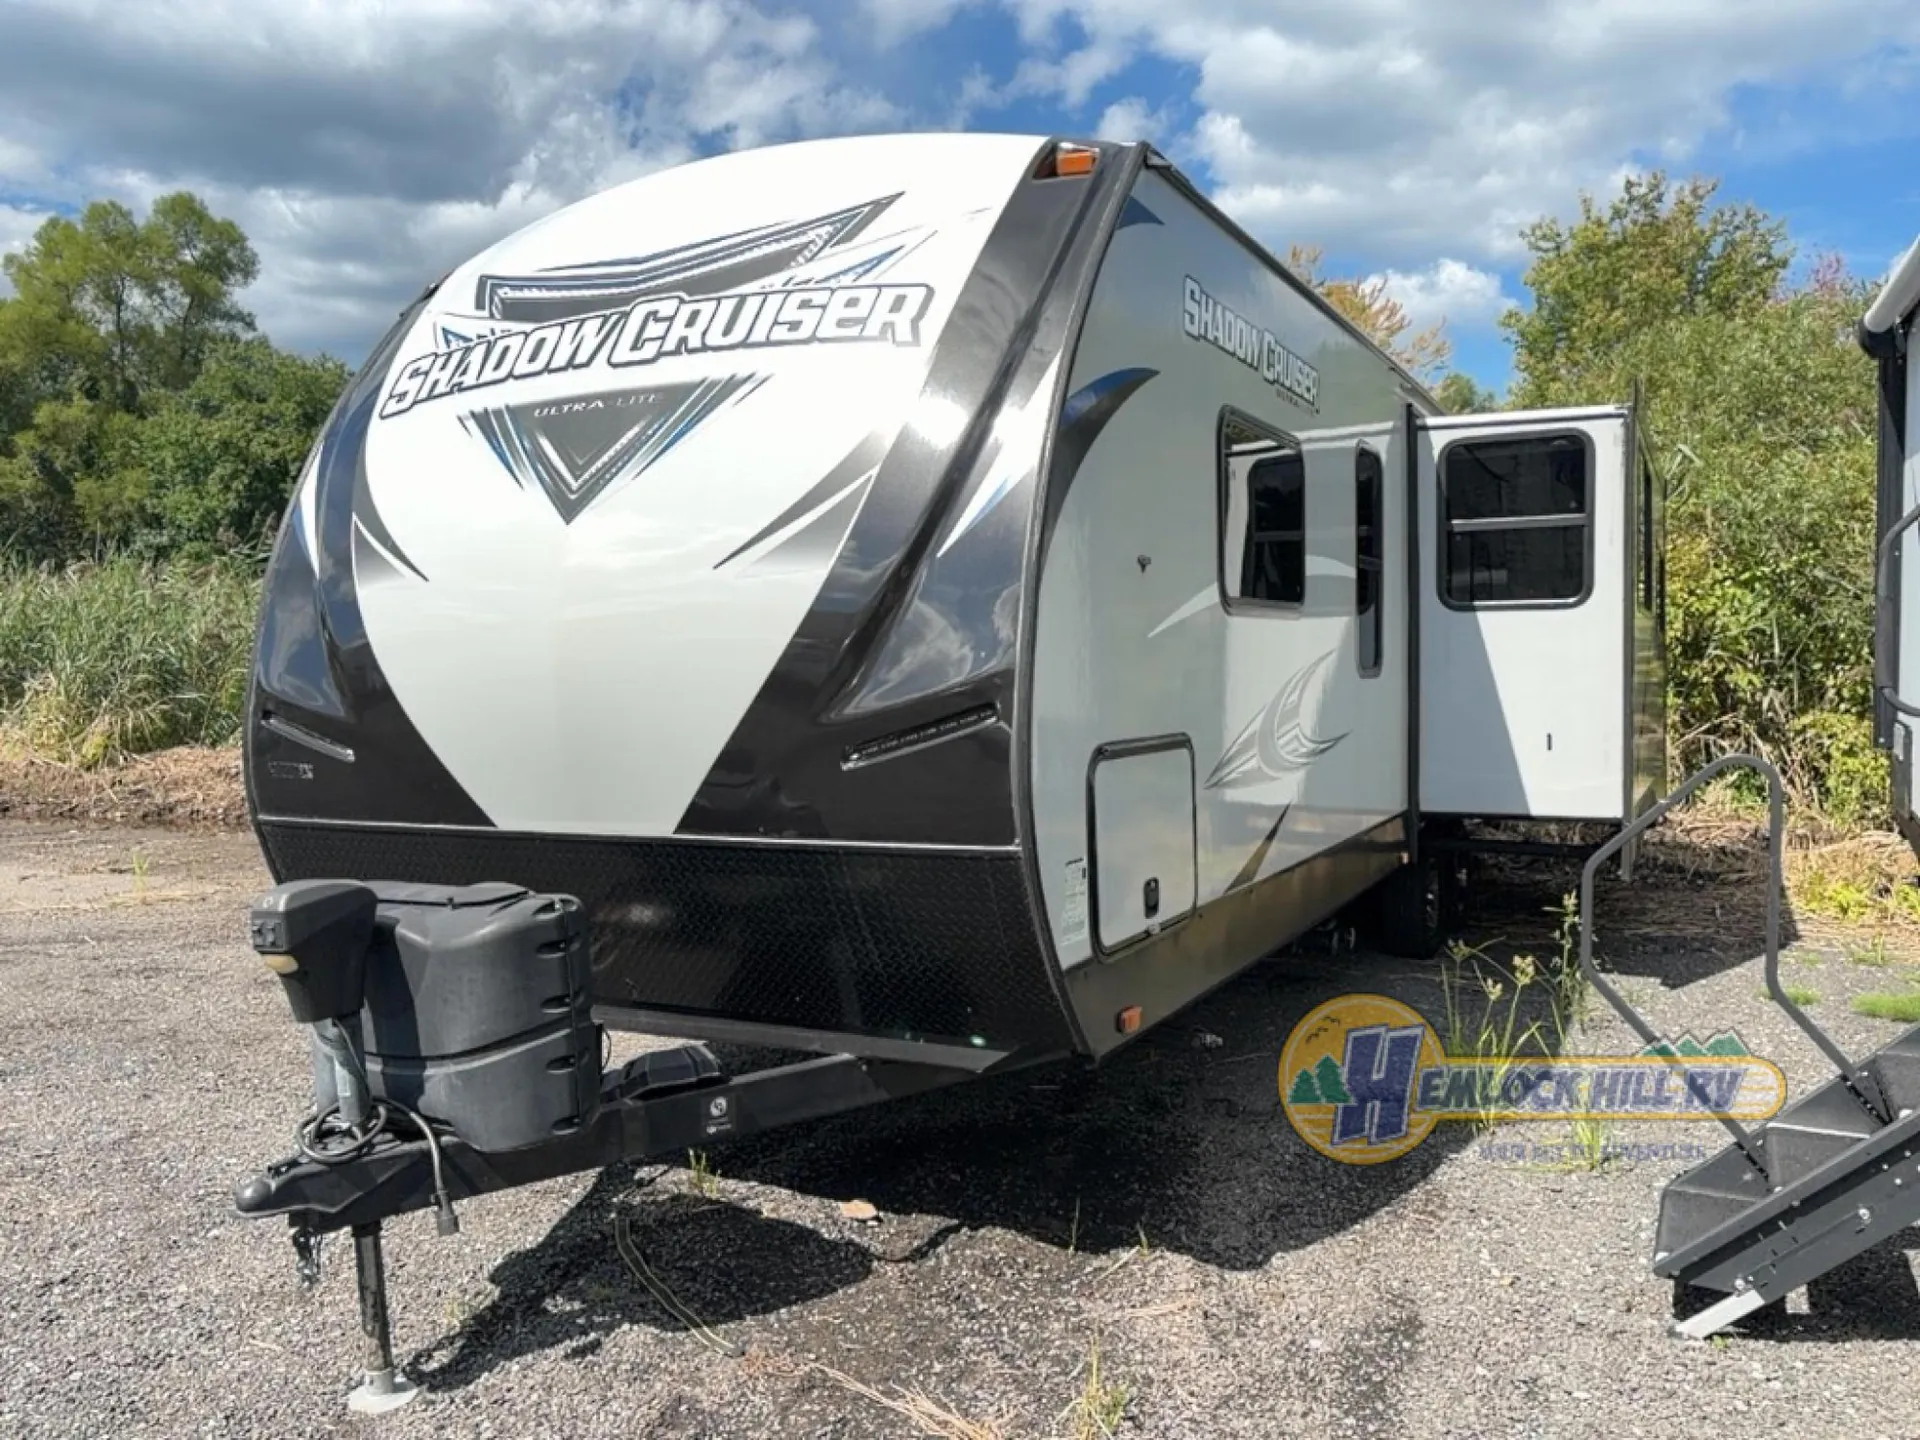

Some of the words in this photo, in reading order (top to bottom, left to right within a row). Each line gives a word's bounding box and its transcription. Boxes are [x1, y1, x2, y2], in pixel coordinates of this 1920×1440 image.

[379, 306, 625, 419] SHADOW
[608, 284, 933, 367] CRUISER
[1183, 274, 1260, 371] SHADOW
[1262, 329, 1320, 406] CRUISER
